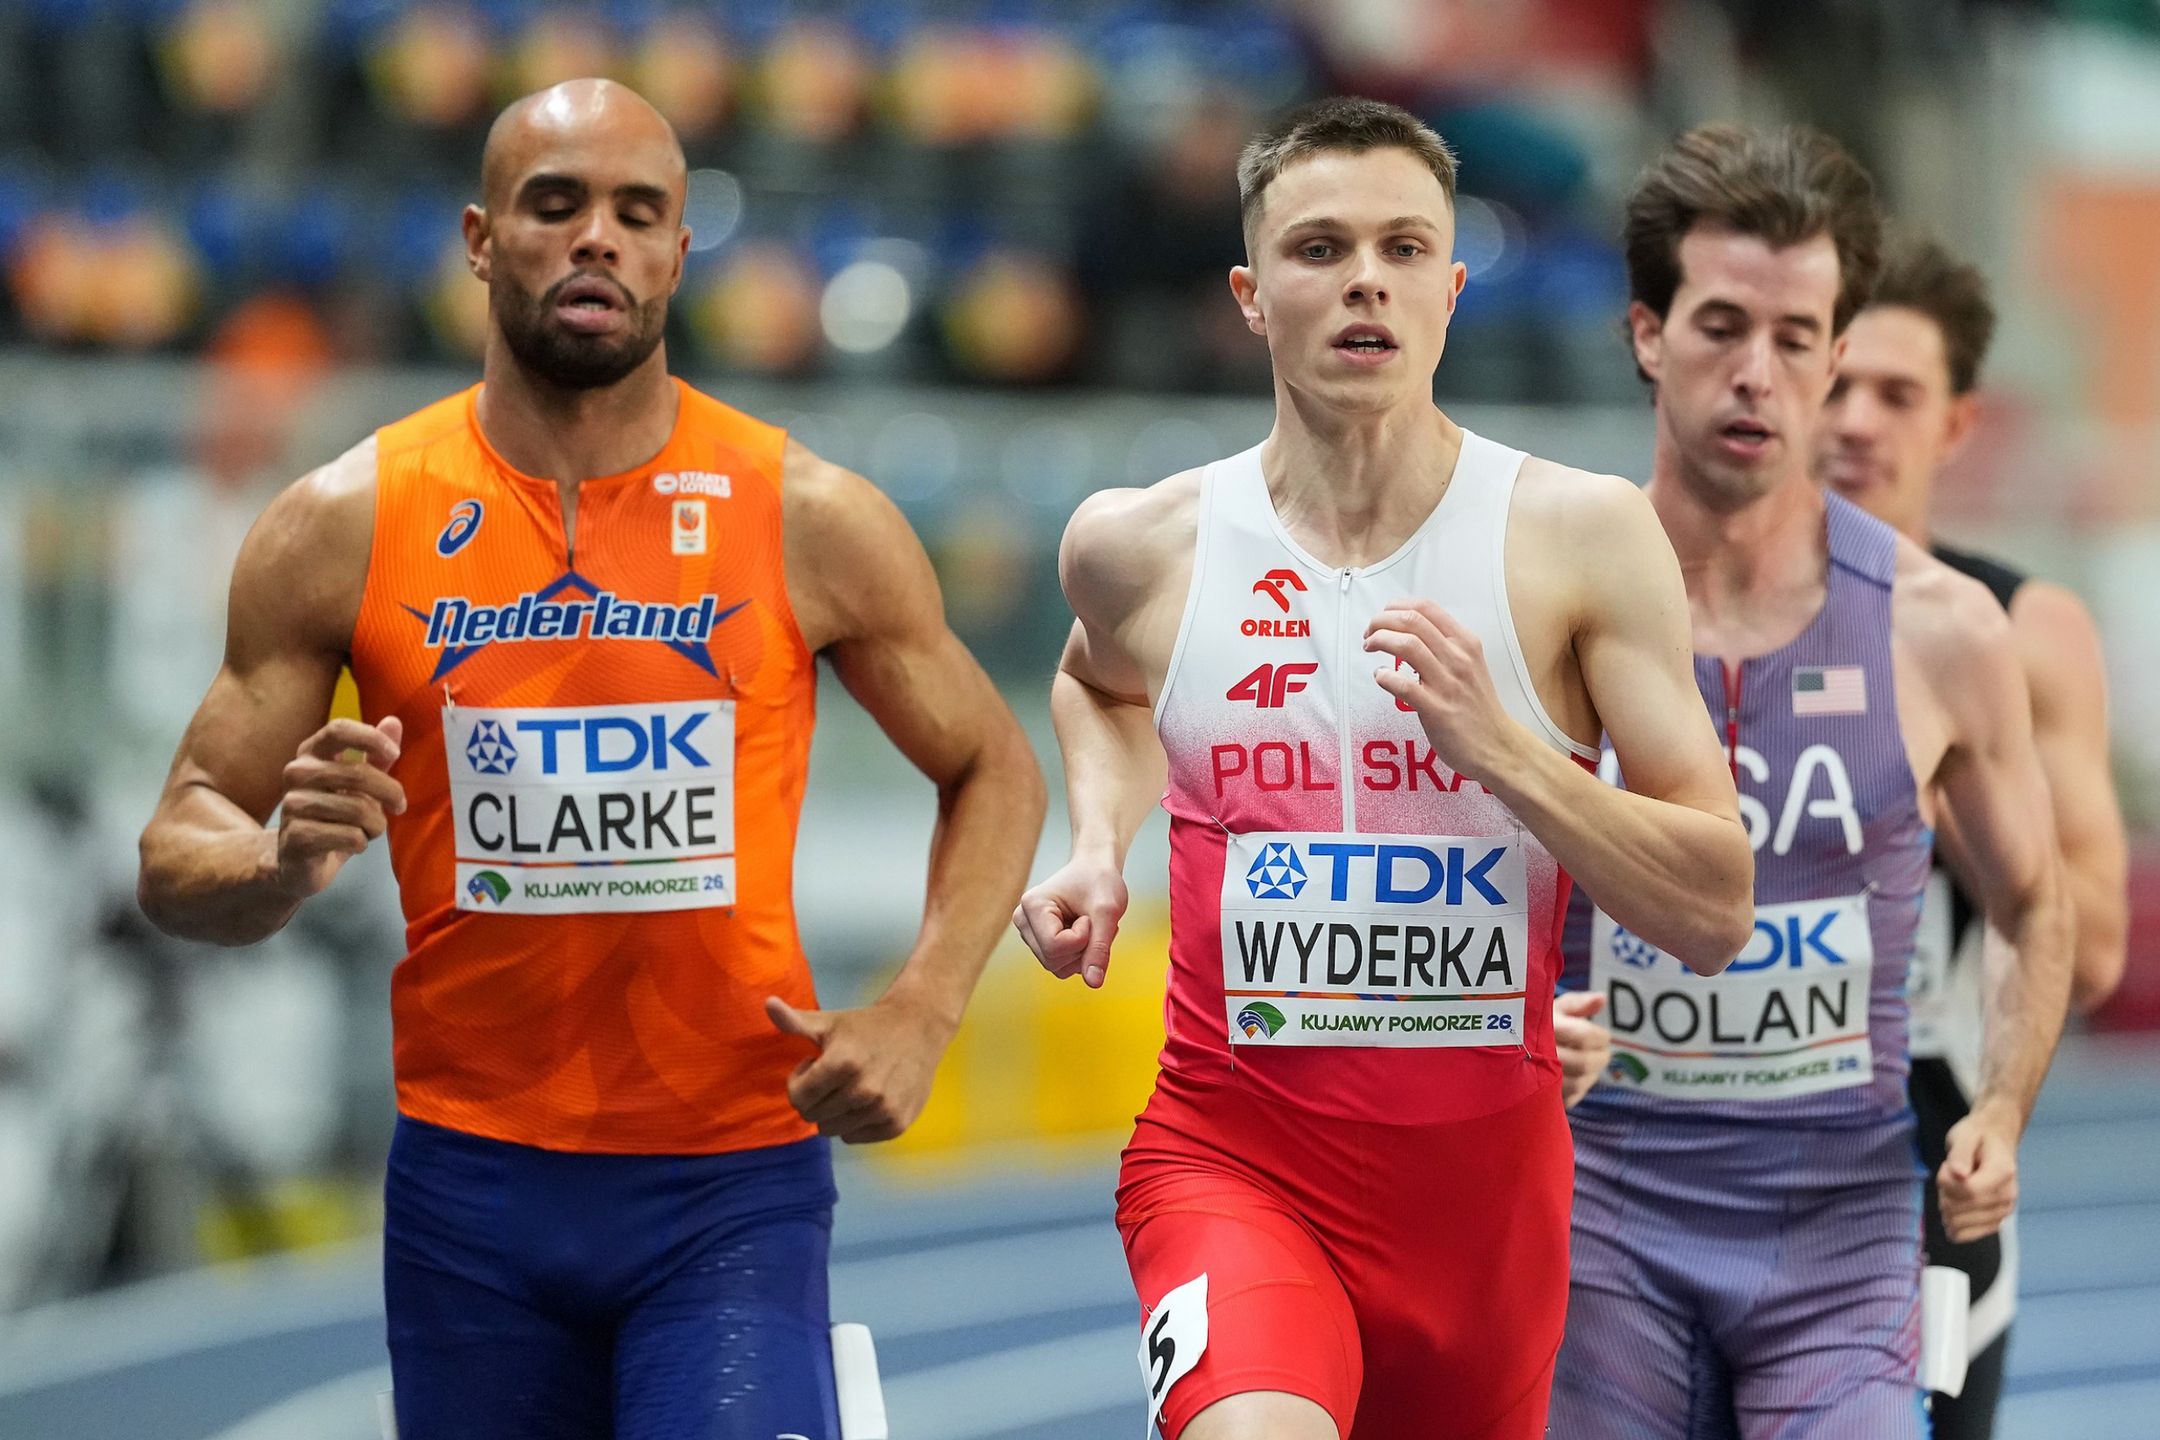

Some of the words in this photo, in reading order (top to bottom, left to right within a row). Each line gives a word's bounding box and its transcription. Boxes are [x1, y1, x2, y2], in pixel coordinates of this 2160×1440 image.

[426, 593, 717, 645] Nederland
[1240, 619, 1311, 637] ORLEN
[1226, 663, 1319, 708] 4F
[517, 712, 712, 774] TDK
[469, 787, 716, 853] CLARKE
[1600, 744, 1864, 856] SA
[524, 881, 603, 898] KUJAWY
[607, 877, 698, 896] POMORZE
[704, 874, 724, 890] 26
[1309, 843, 1508, 905] TDK
[1235, 920, 1513, 987] WYDERKA
[1681, 910, 1846, 974] DK
[1300, 1014, 1385, 1031] KUJAWY
[1388, 1014, 1482, 1031] POMORZE
[1486, 1014, 1512, 1030] 26
[1608, 979, 1848, 1044] DOLAN
[1148, 1310, 1175, 1400] 5
